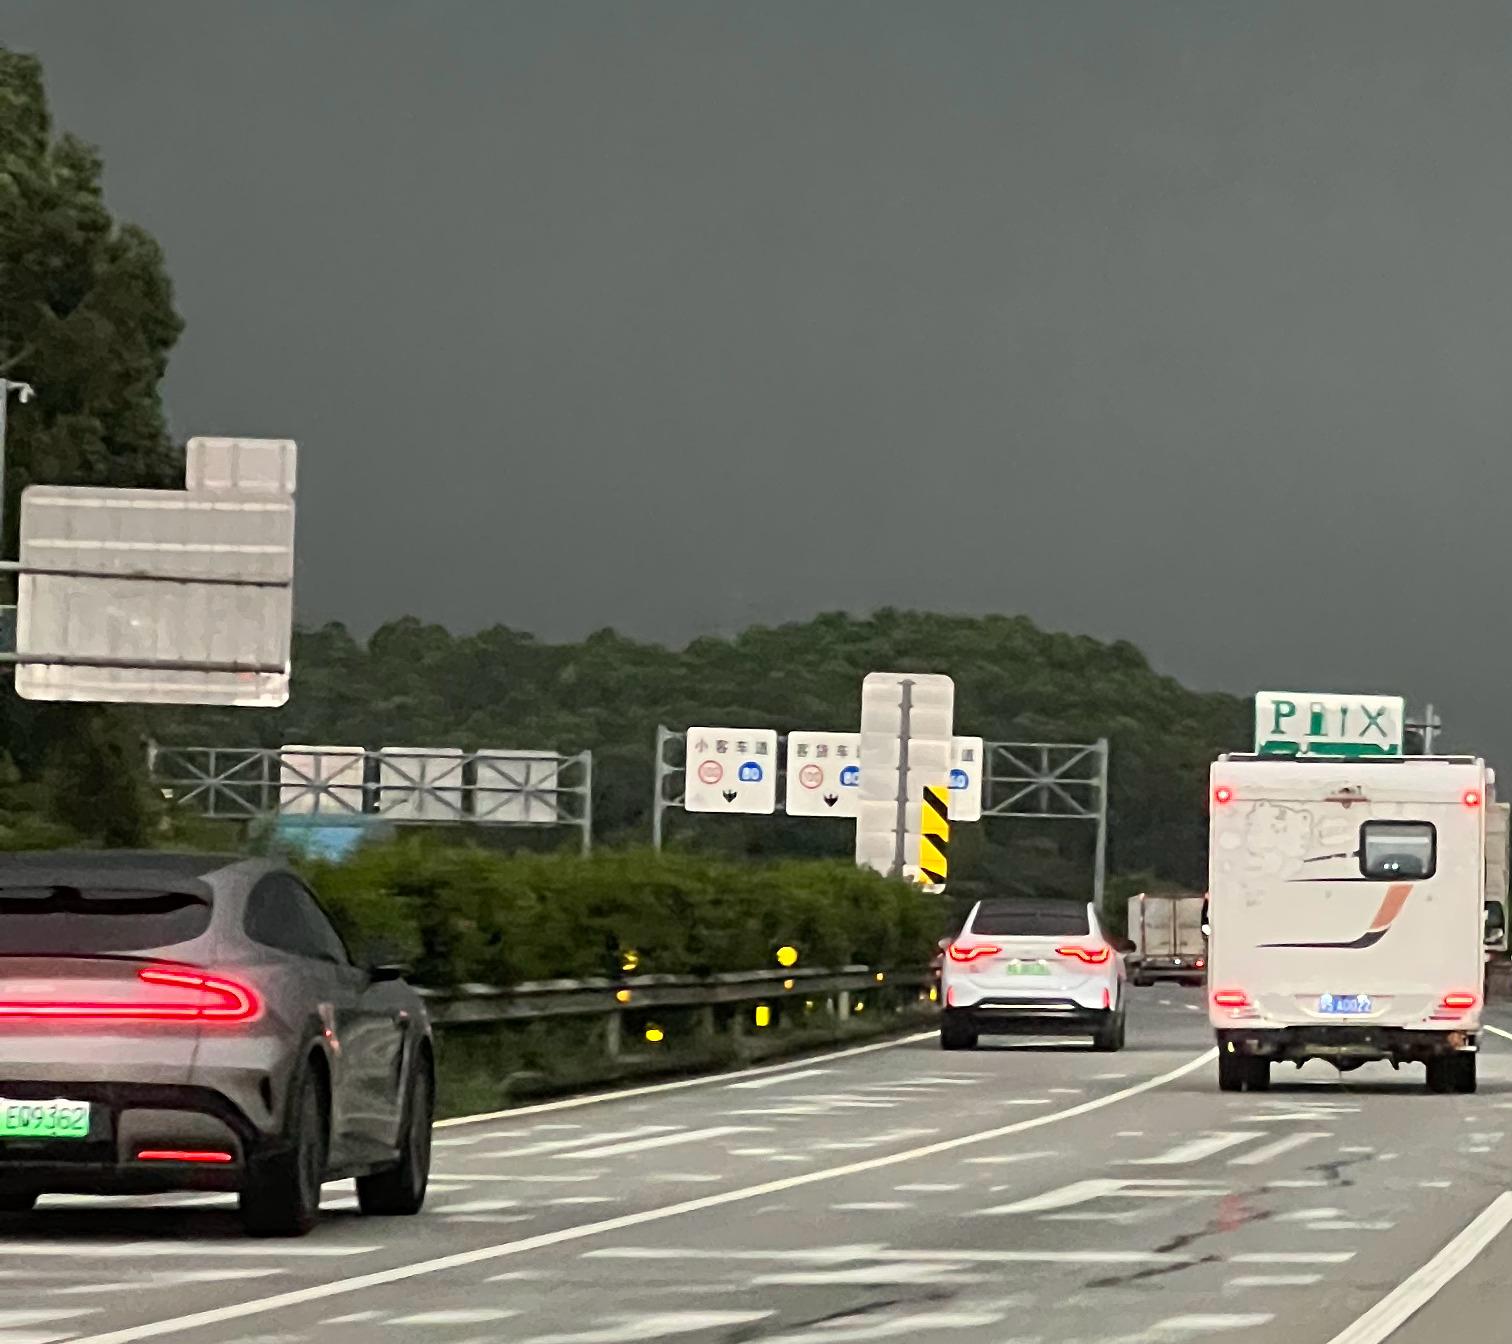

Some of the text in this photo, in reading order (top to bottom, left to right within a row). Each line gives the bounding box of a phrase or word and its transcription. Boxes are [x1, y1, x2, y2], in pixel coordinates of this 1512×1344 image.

[1270, 700, 1296, 735] P
[796, 743, 860, 759] 客货车
